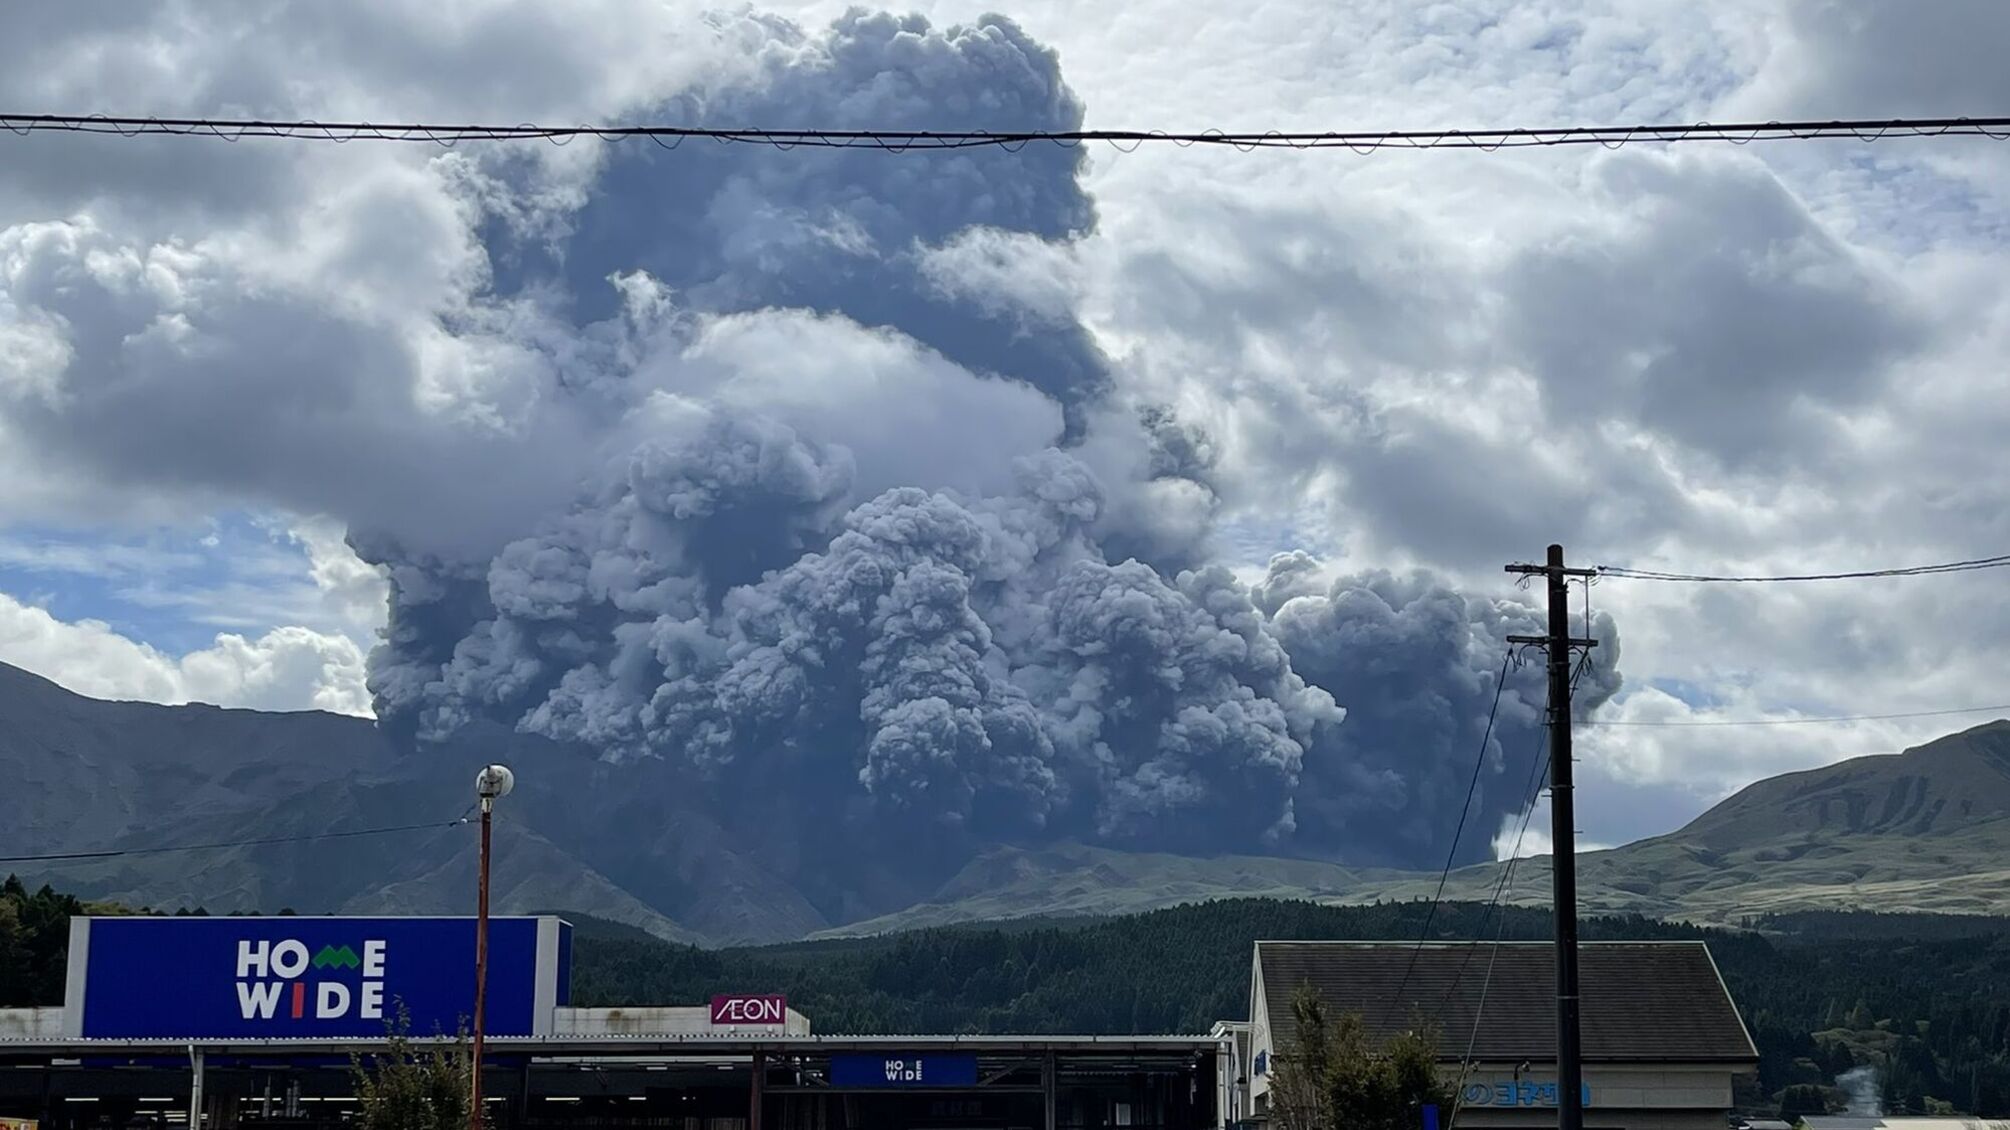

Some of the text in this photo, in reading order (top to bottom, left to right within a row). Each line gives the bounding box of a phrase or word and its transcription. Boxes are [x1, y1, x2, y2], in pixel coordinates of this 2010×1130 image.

[236, 939, 386, 978] HOME
[235, 981, 384, 1019] WIDE
[885, 1070, 922, 1081] WIDE
